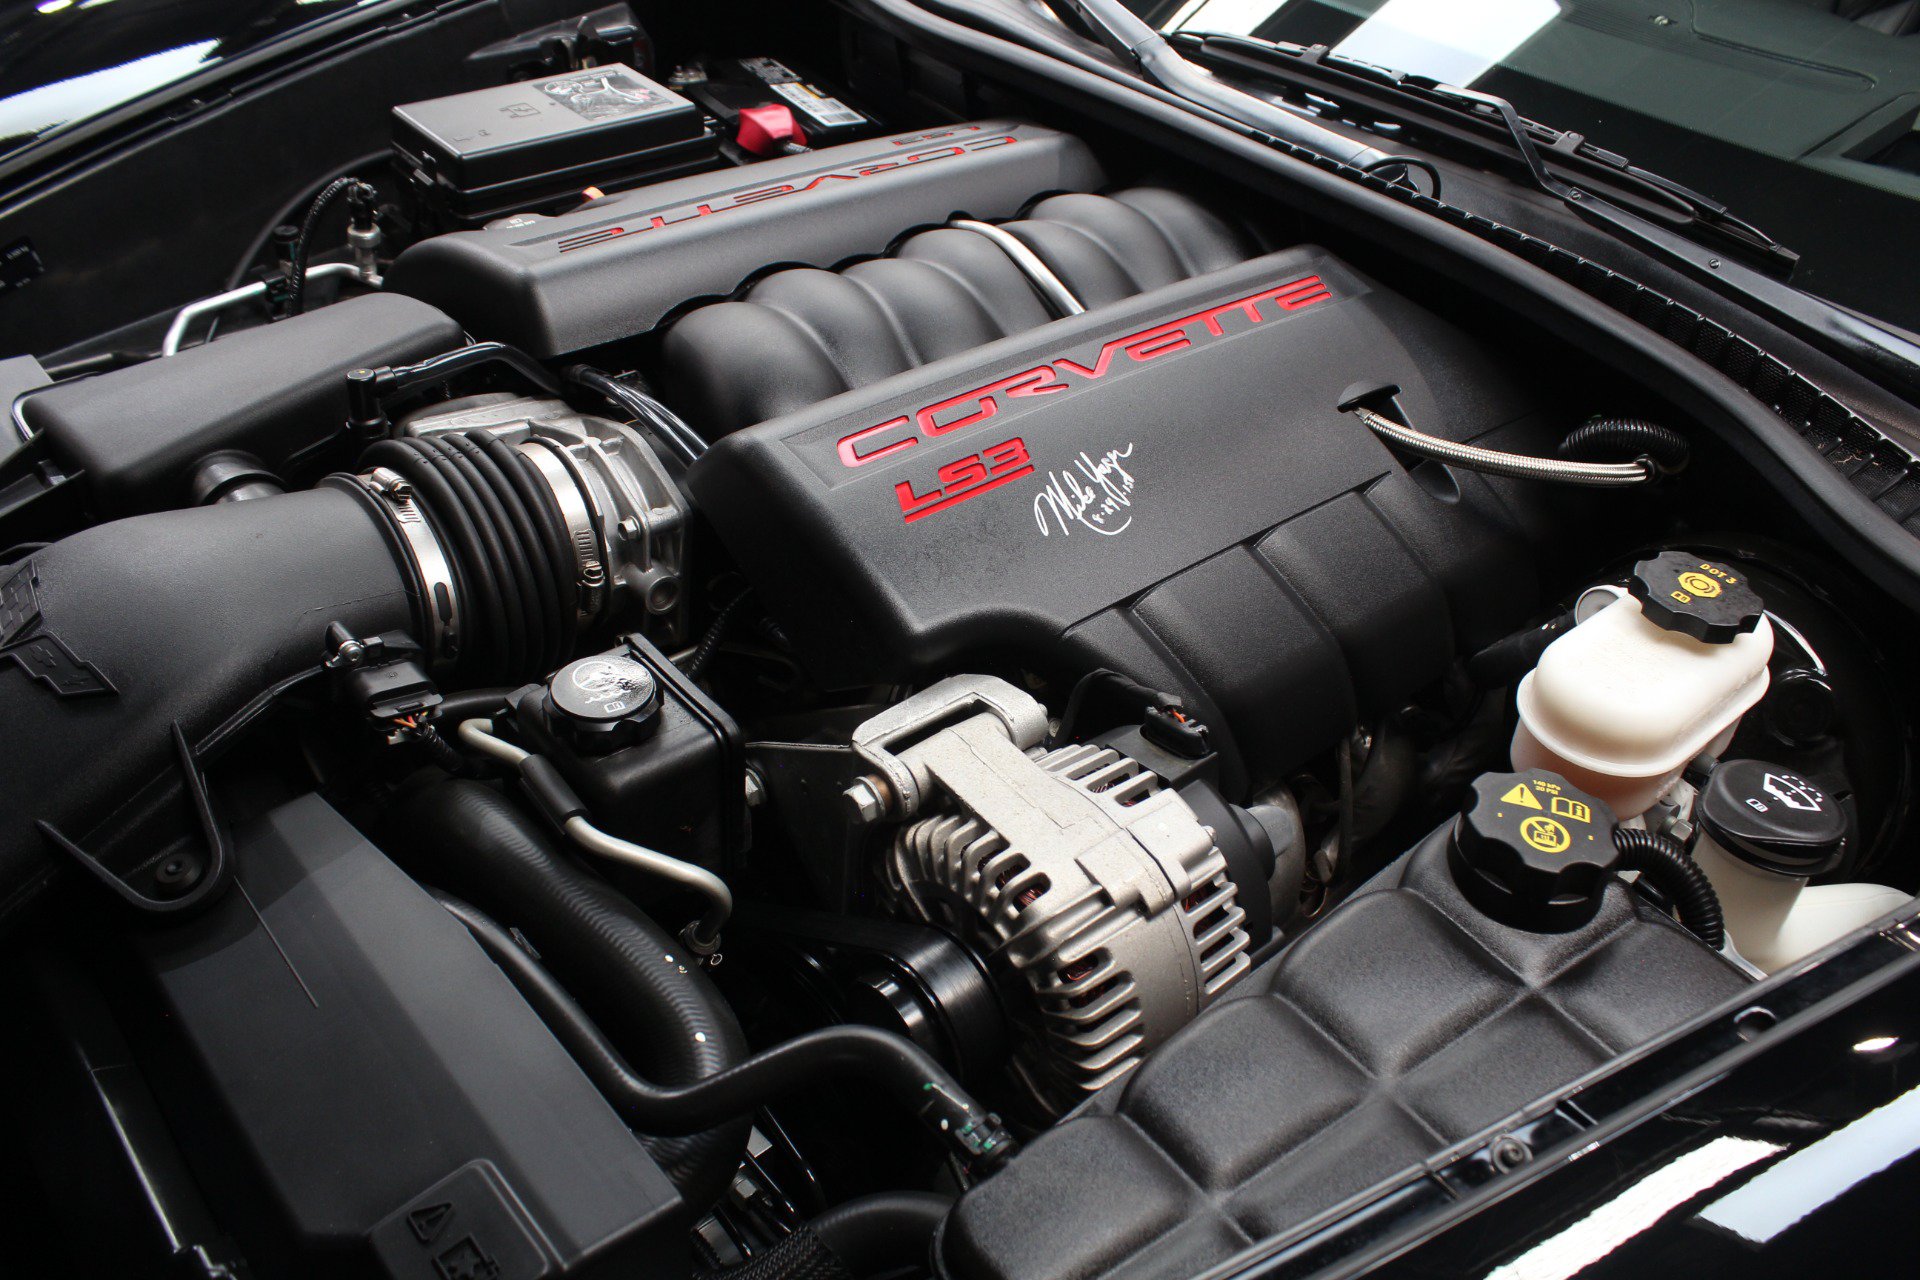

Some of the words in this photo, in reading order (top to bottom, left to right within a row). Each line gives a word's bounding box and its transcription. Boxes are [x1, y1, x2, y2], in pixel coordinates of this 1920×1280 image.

[558, 135, 1018, 253] CORVETTE
[836, 274, 1333, 468] CORVETTE
[894, 436, 1031, 514] LS3
[1699, 563, 1728, 578] DOT
[1725, 576, 1738, 585] 3
